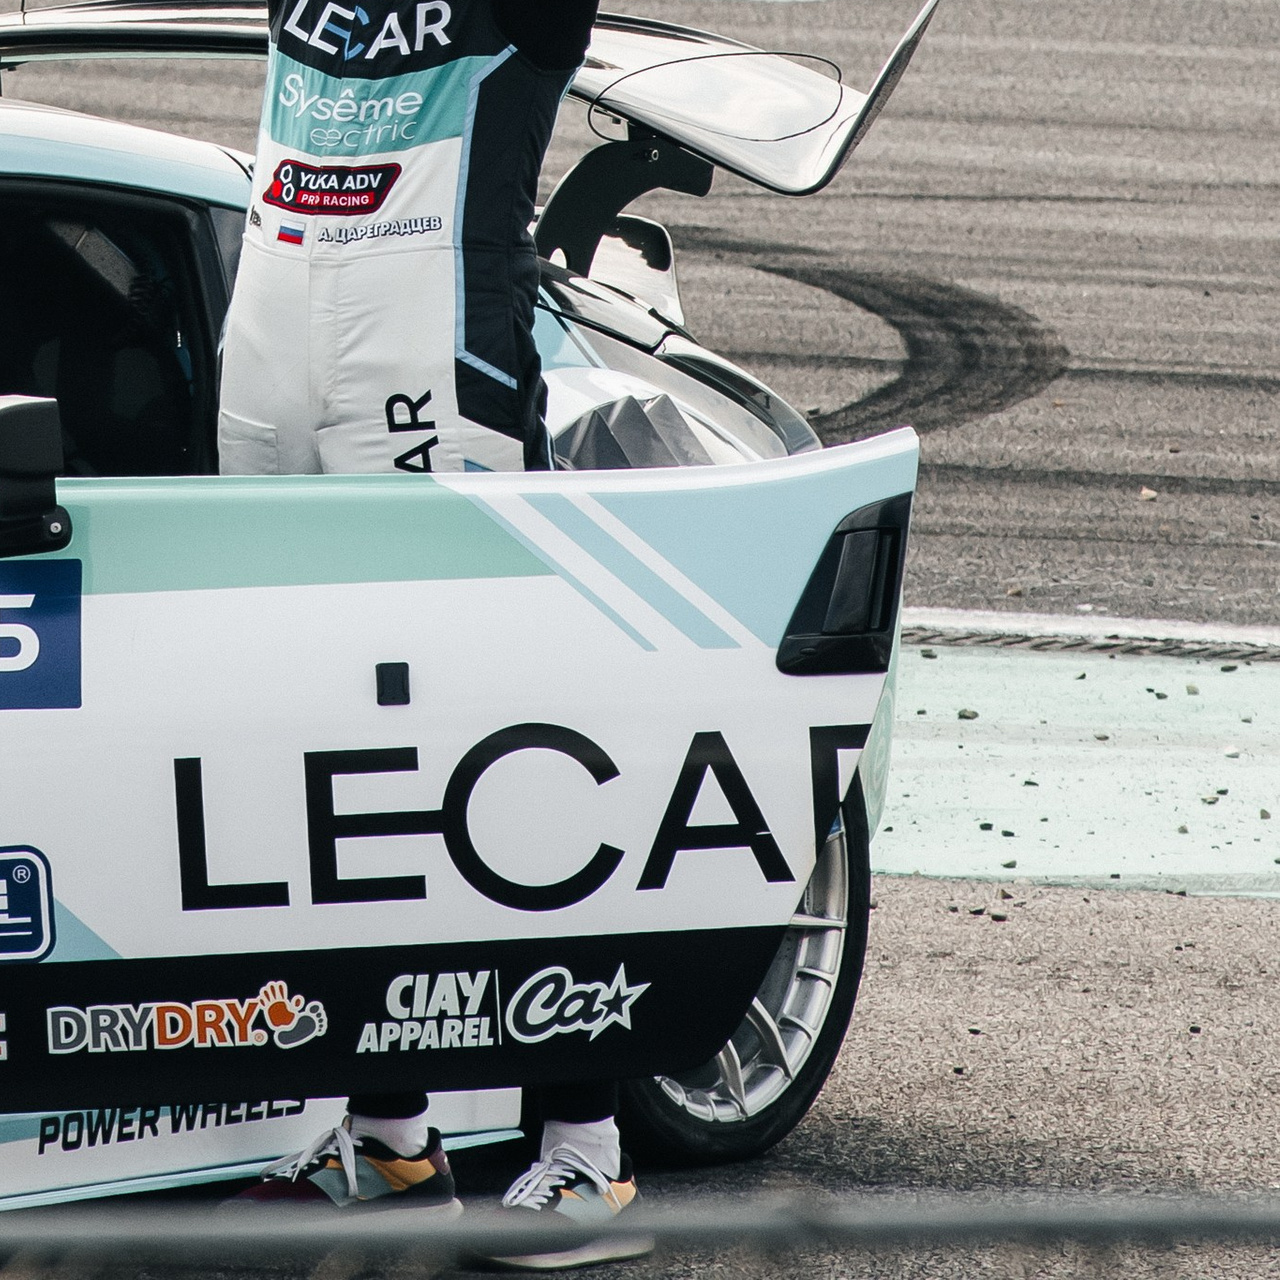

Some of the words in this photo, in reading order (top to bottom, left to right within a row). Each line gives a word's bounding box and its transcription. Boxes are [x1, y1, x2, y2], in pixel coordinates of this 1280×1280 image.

[300, 171, 339, 190] YUKA
[342, 172, 382, 190] ADV
[323, 195, 370, 206] RACING
[335, 216, 443, 245] ЦАРЕГРАДЦЕВ
[356, 1016, 494, 1053] APPAREL
[38, 1106, 161, 1155] POWER
